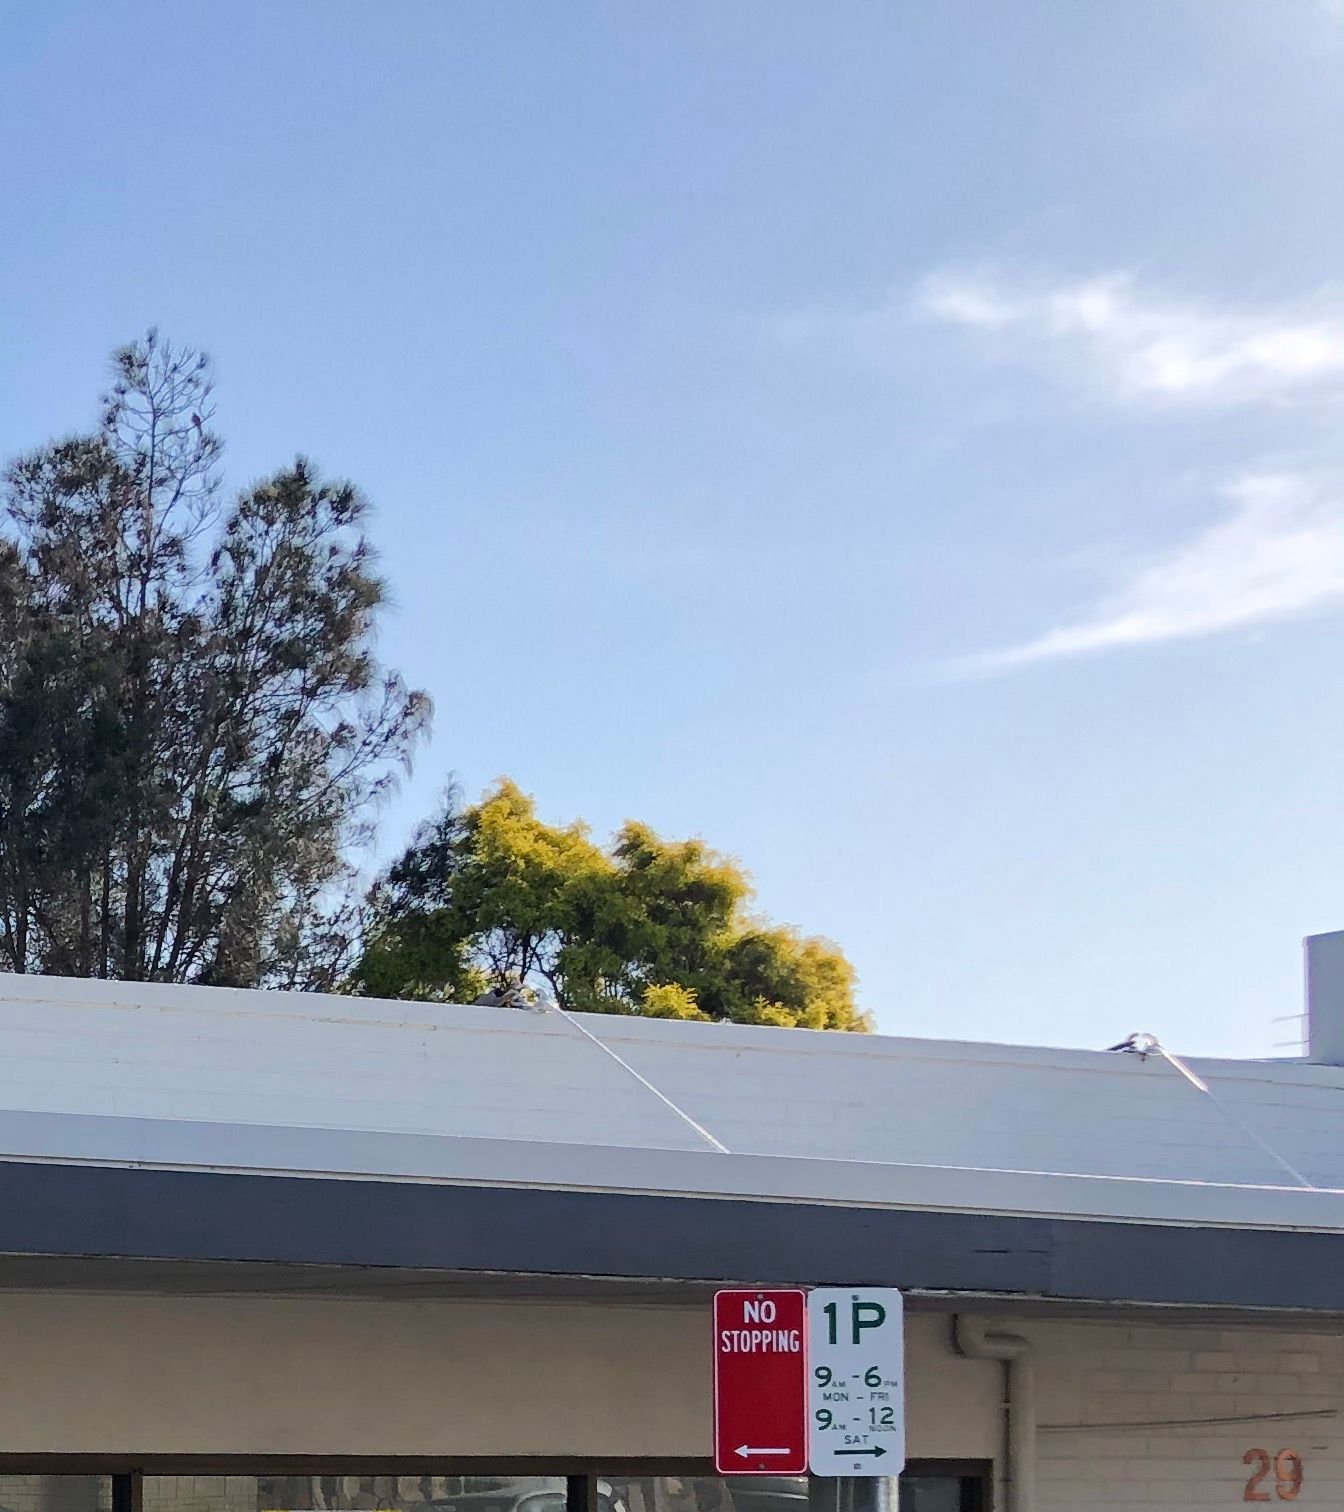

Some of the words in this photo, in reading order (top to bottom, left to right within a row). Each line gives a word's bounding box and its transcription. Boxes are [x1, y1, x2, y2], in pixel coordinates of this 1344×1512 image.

[743, 1301, 776, 1323] NO
[823, 1302, 886, 1345] 1P
[721, 1330, 800, 1353] STOPPING
[823, 1392, 849, 1402] MON
[870, 1392, 889, 1401] FRI
[869, 1406, 894, 1425] 12
[844, 1434, 869, 1445] SAT
[1242, 1448, 1304, 1502] 29
